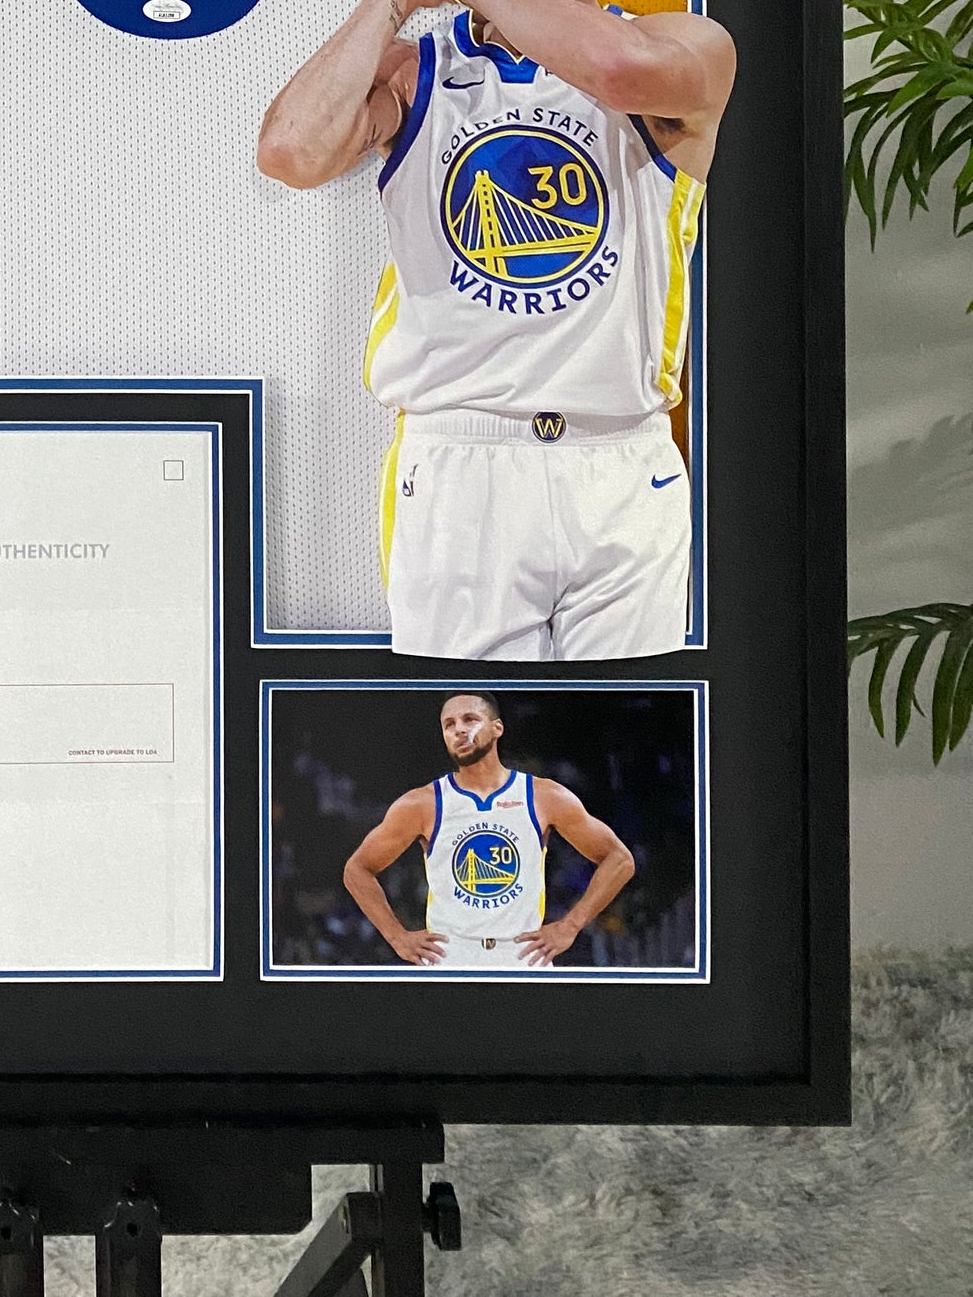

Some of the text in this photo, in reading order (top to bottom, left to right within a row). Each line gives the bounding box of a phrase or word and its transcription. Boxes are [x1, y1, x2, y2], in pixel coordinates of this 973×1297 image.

[441, 108, 599, 165] GOLDEN STATE
[528, 162, 587, 209] 30
[449, 246, 619, 315] WARRIORS
[452, 822, 520, 846] GOLDEN STATE
[489, 846, 513, 865] 30
[453, 883, 523, 909] WARRIORS
